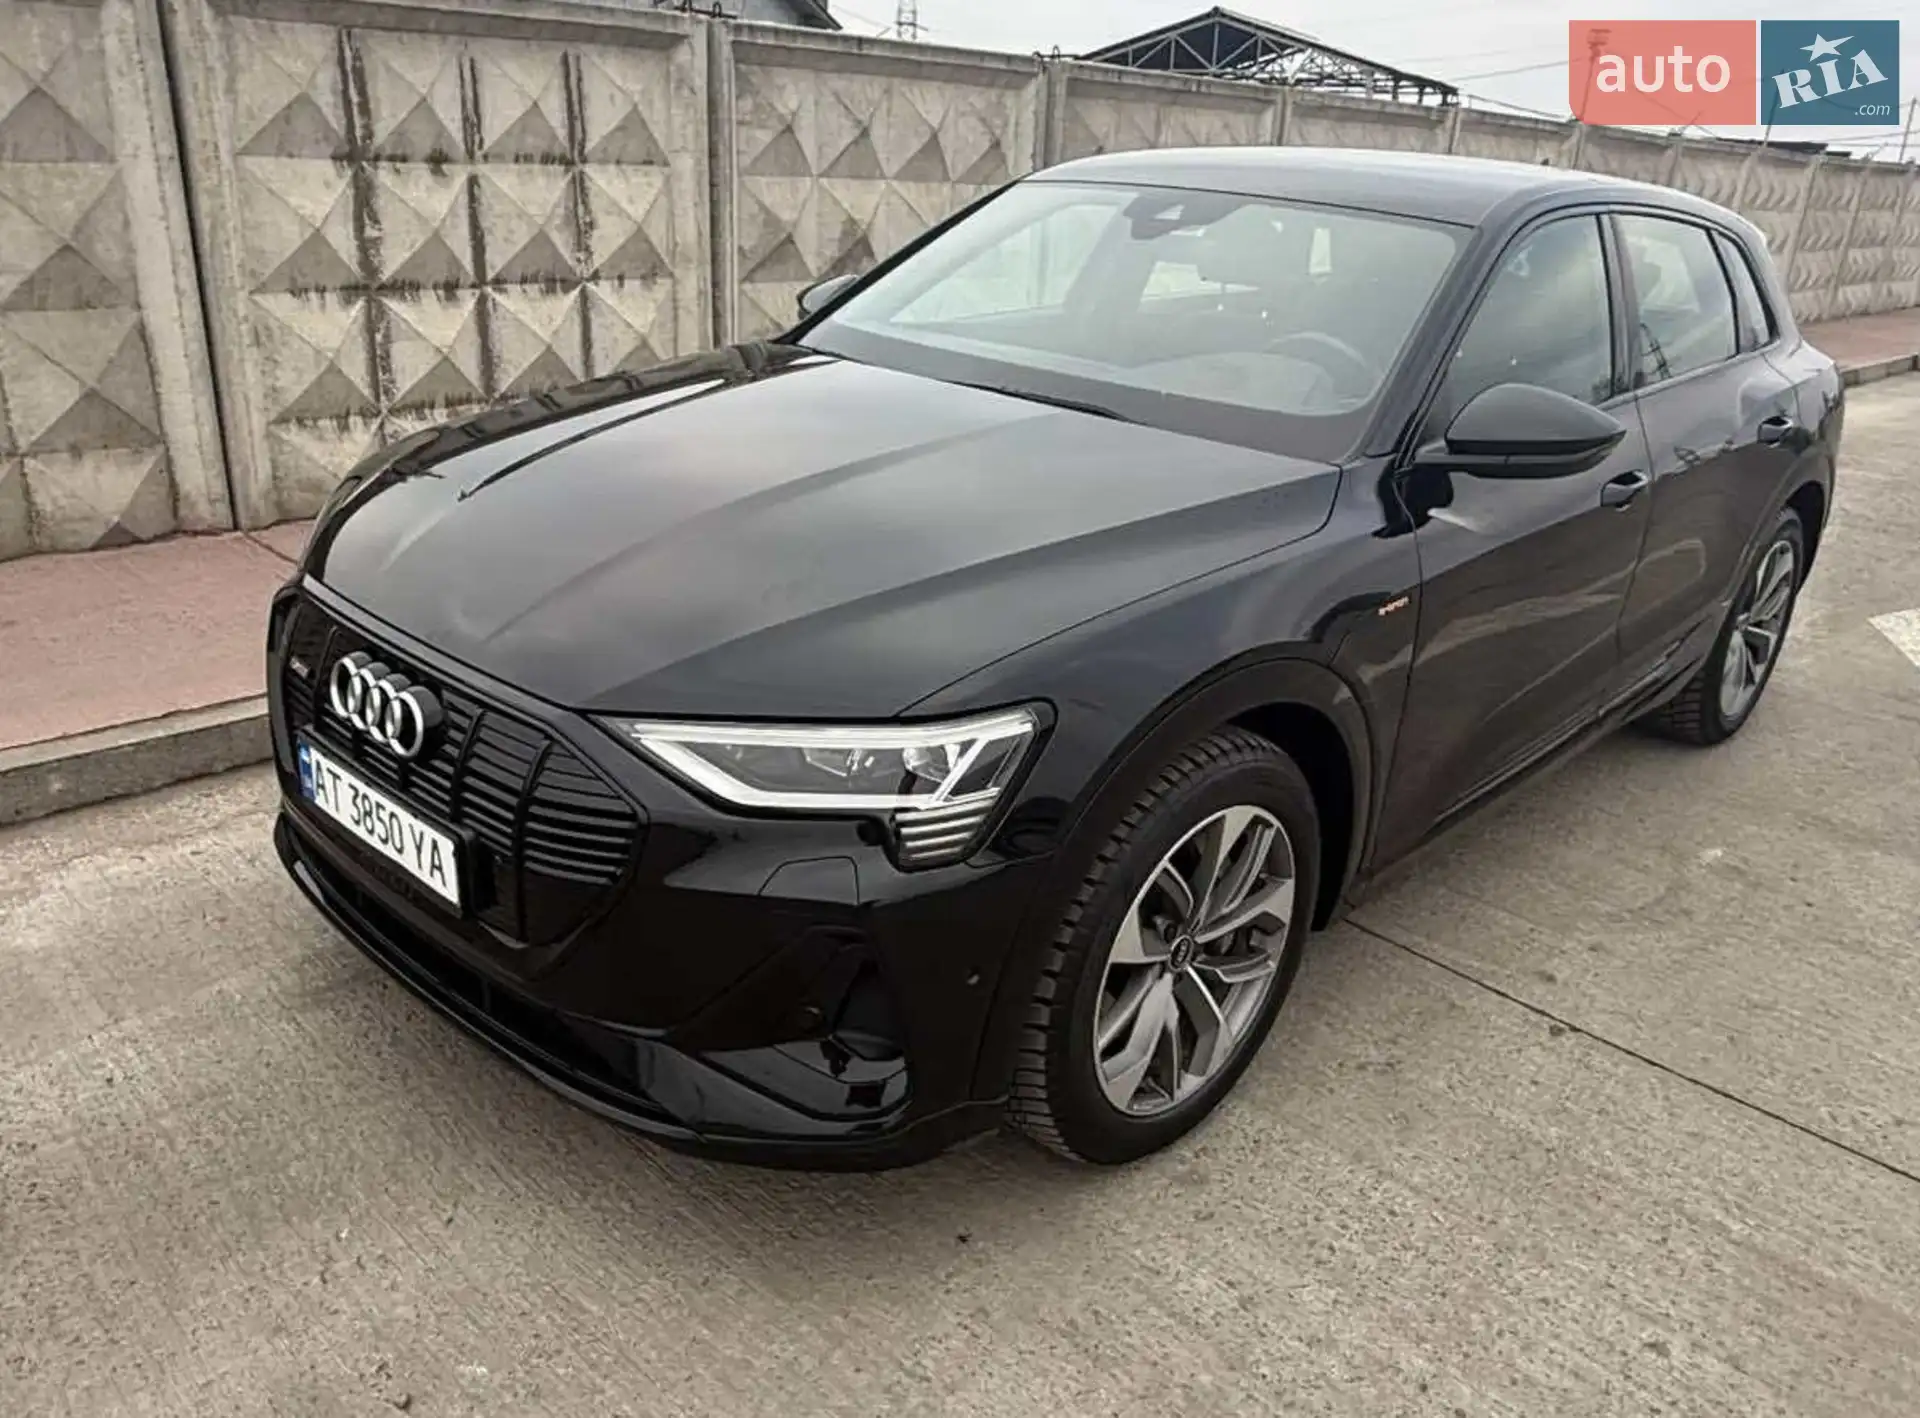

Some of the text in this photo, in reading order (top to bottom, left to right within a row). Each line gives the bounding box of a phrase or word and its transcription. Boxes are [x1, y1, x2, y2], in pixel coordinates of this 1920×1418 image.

[315, 757, 343, 812] AT
[349, 785, 405, 853] 3850
[409, 824, 447, 888] YA
